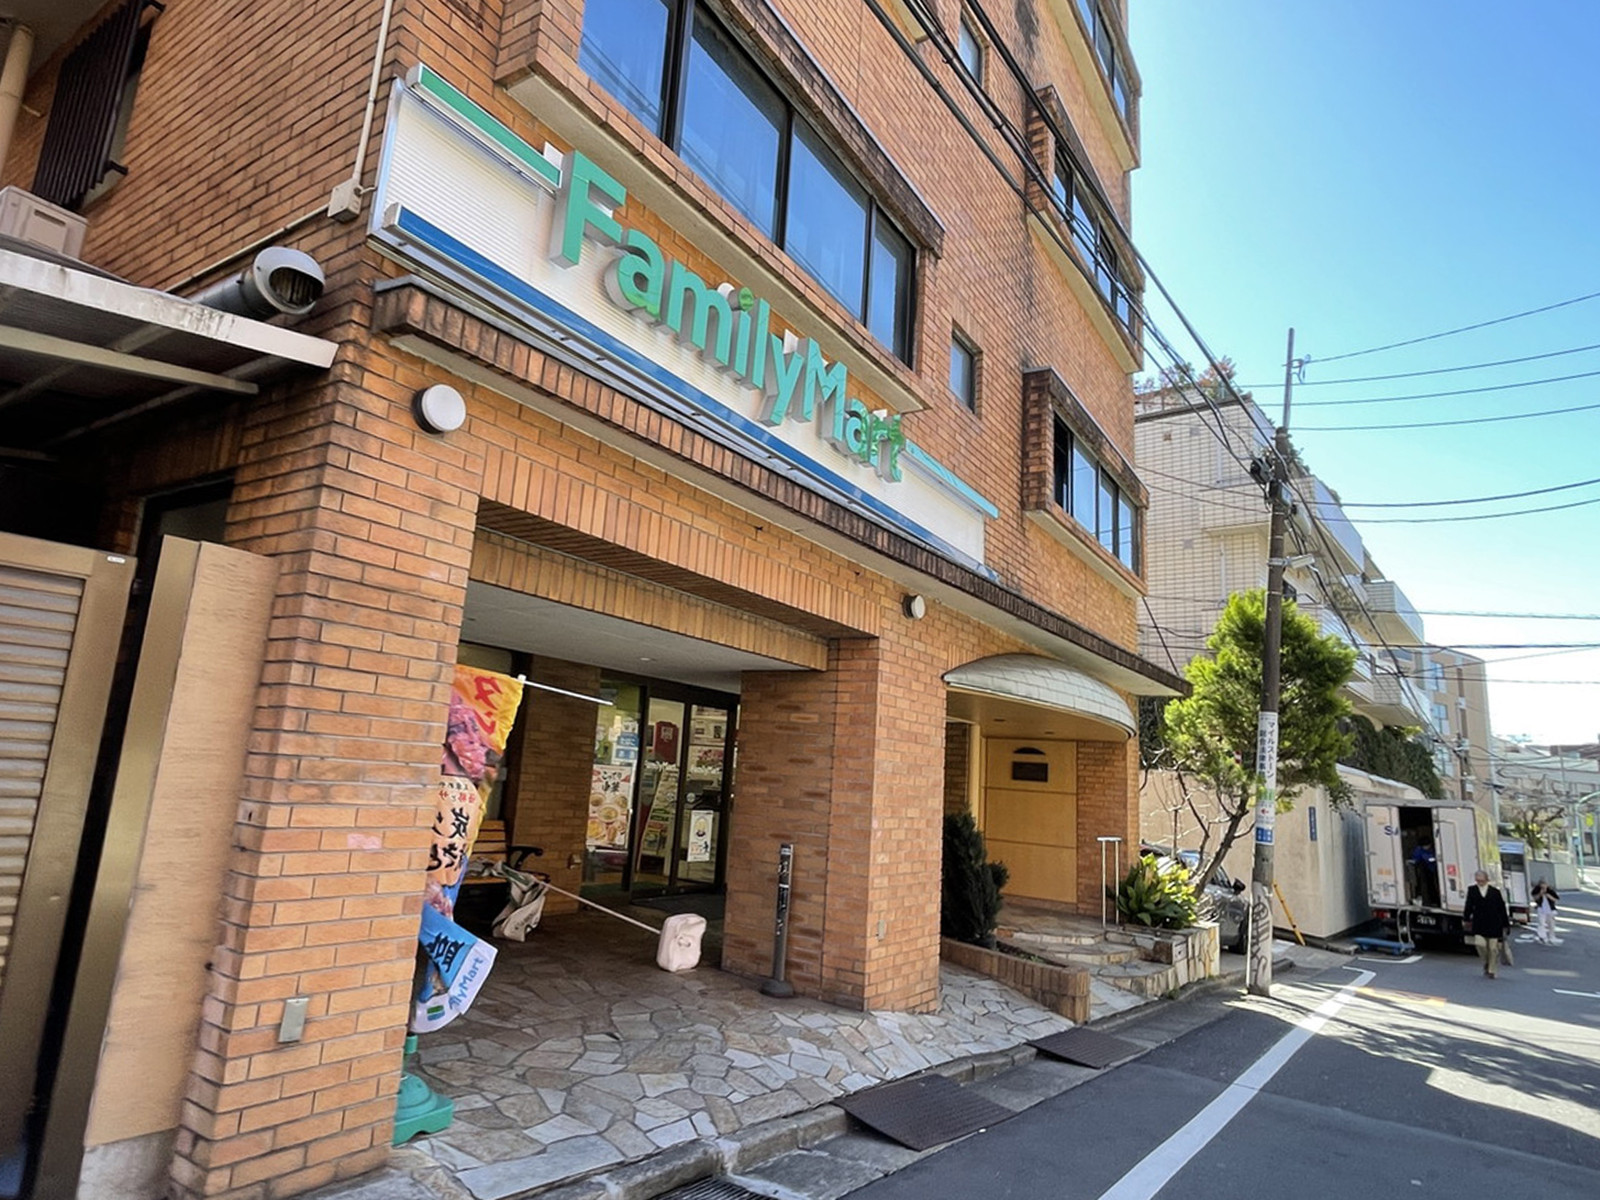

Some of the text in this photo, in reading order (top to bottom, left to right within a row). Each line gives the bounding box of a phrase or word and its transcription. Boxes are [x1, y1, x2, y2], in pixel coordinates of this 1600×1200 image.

[551, 149, 905, 483] FamilyMart
[1266, 721, 1276, 778] マイルストーン
